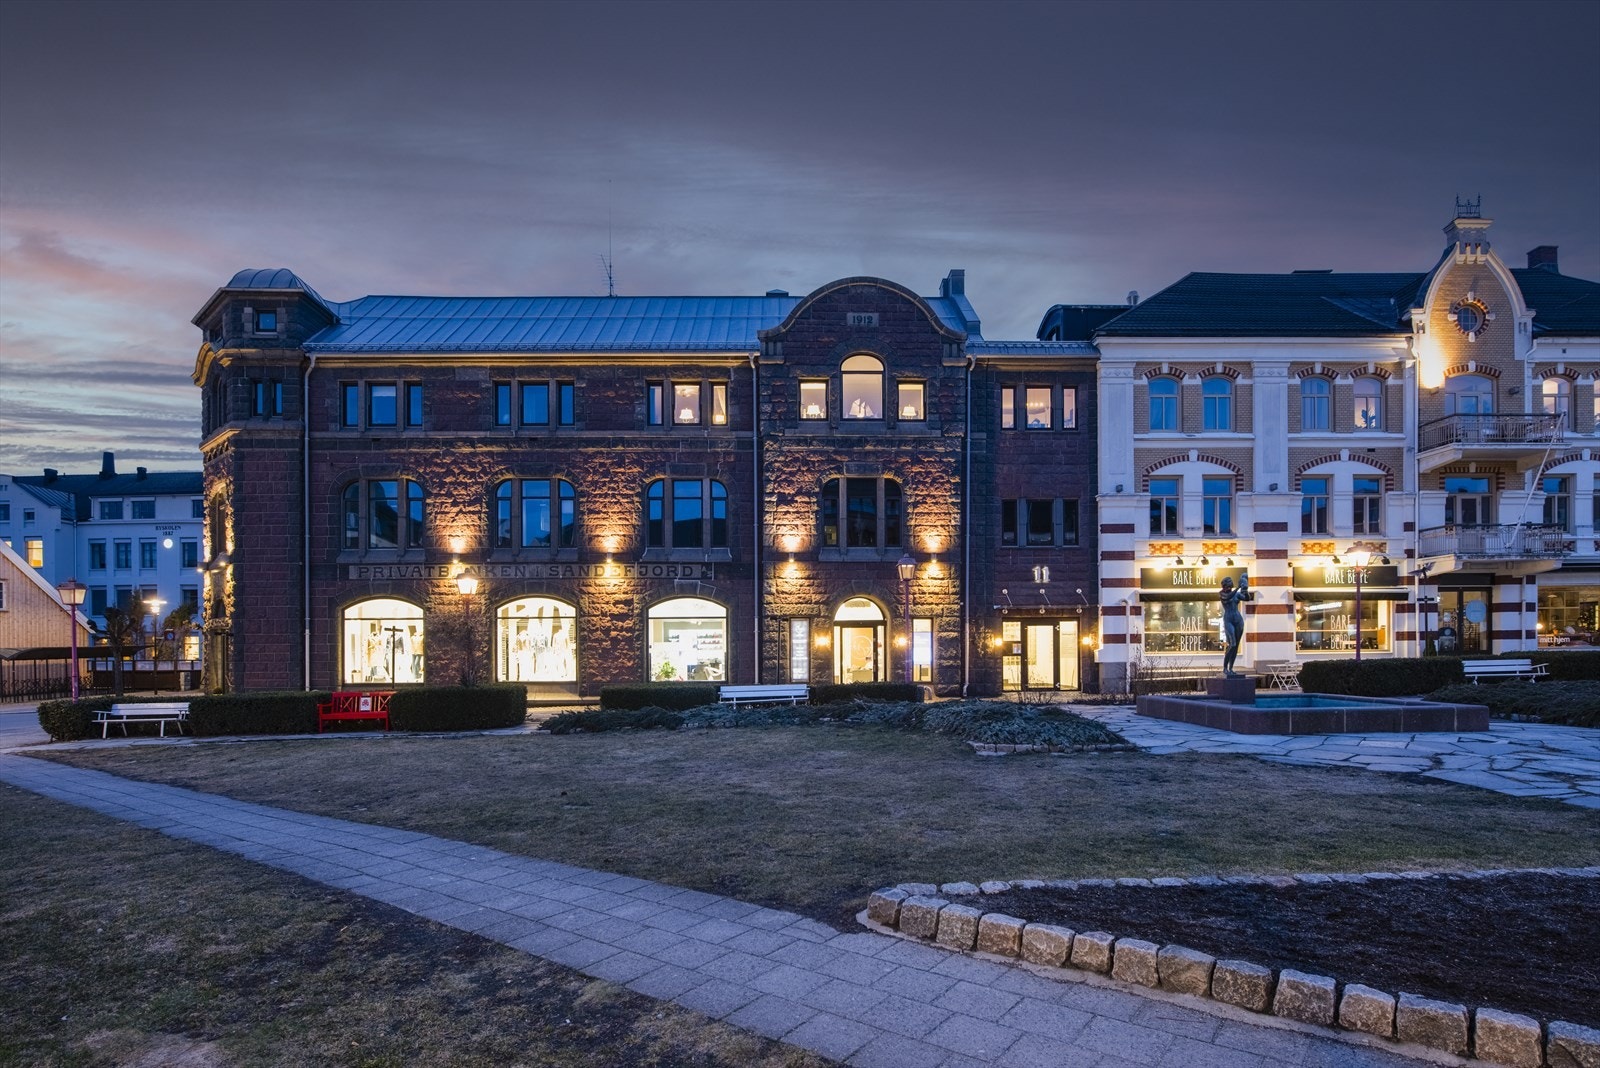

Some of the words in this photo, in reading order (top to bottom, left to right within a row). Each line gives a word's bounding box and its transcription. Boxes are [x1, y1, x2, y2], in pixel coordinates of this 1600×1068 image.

[852, 315, 873, 324] 1912
[358, 566, 526, 578] PRIVATBNKEN
[535, 566, 540, 577] I
[549, 565, 693, 577] SANDEFJORD
[1032, 566, 1050, 583] 11
[1172, 570, 1193, 585] BARE
[1324, 569, 1345, 584] BARE
[1347, 569, 1368, 584] BEPE
[1180, 616, 1201, 631] BARE
[1330, 614, 1351, 630] BARE
[1180, 635, 1202, 651] BEPPE
[1554, 636, 1570, 645] hjem
